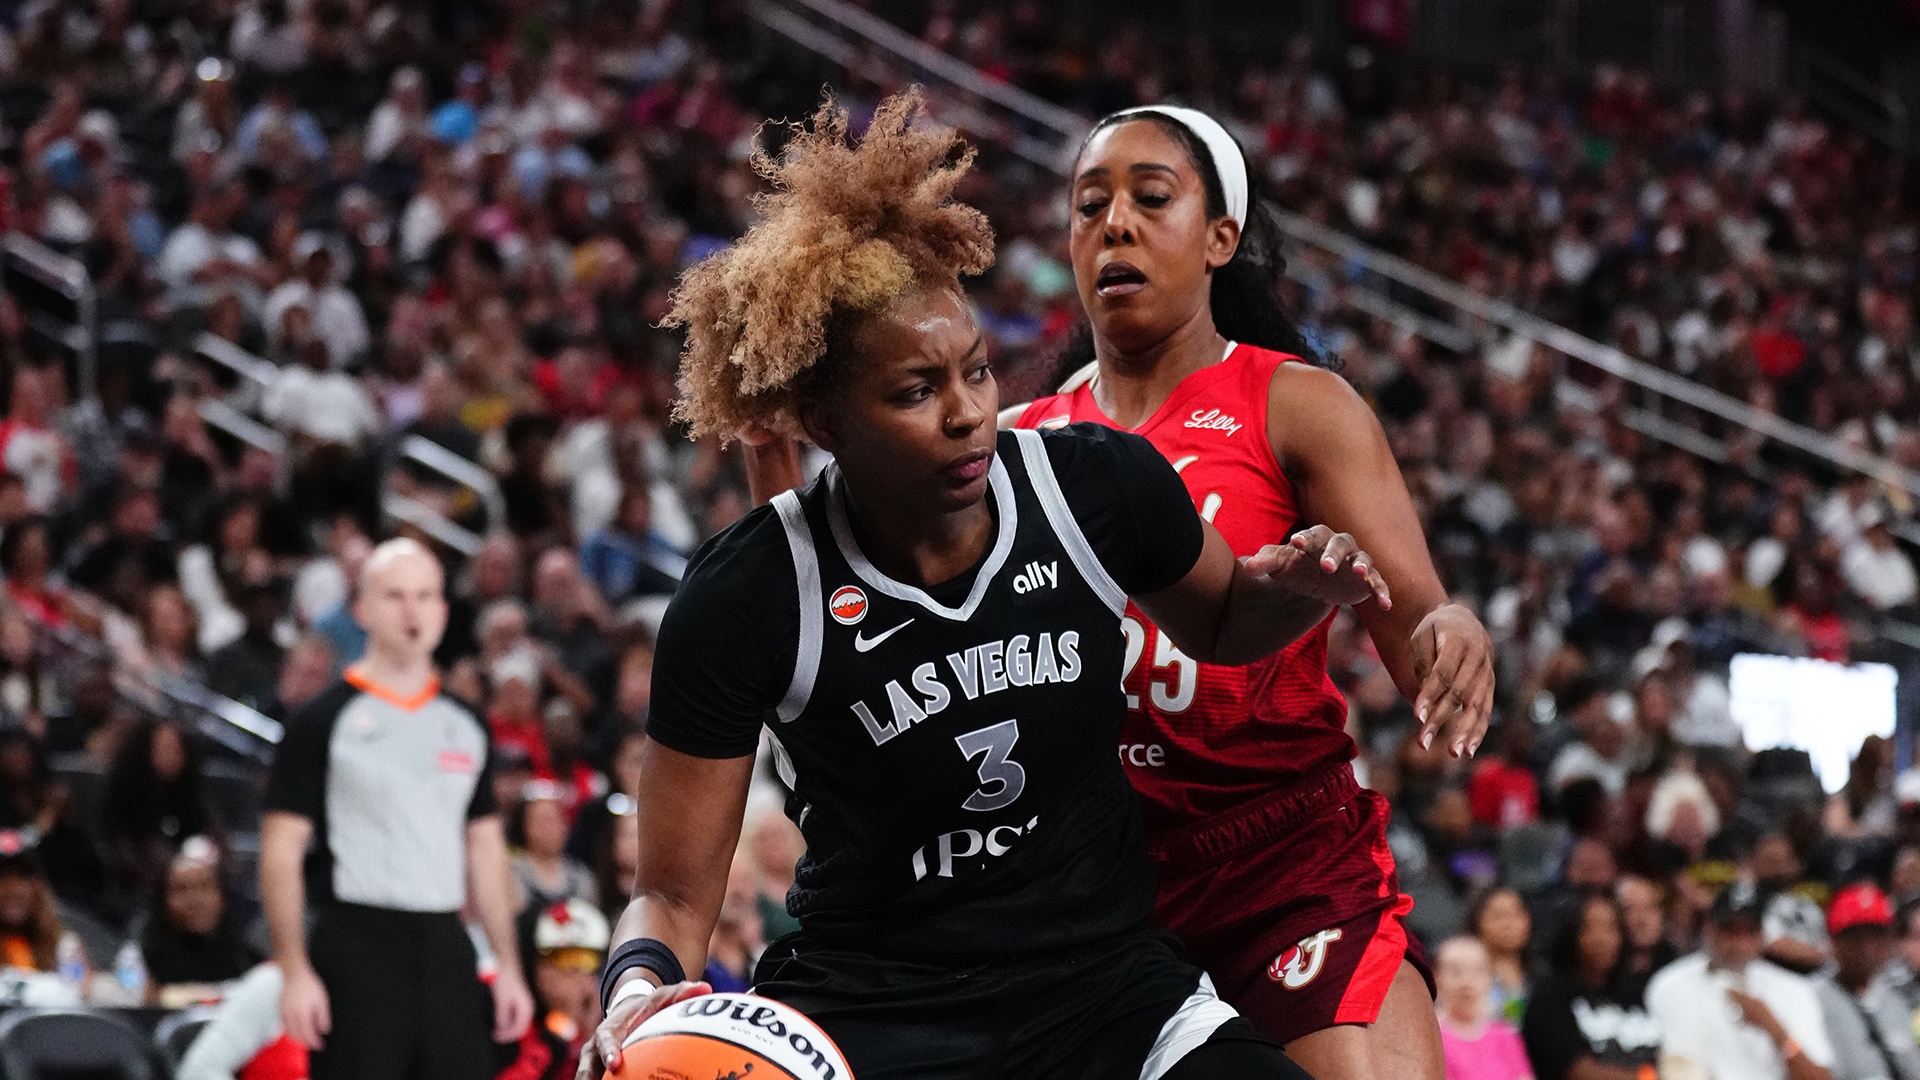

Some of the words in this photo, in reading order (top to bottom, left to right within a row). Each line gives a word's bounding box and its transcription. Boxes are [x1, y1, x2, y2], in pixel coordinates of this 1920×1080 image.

[1184, 409, 1242, 437] Lilly
[1012, 561, 1058, 594] ally
[850, 662, 951, 747] LAS
[946, 630, 1082, 700] VEGAS
[1120, 614, 1198, 714] 25
[954, 719, 1026, 812] 3
[677, 998, 836, 1080] Wilson
